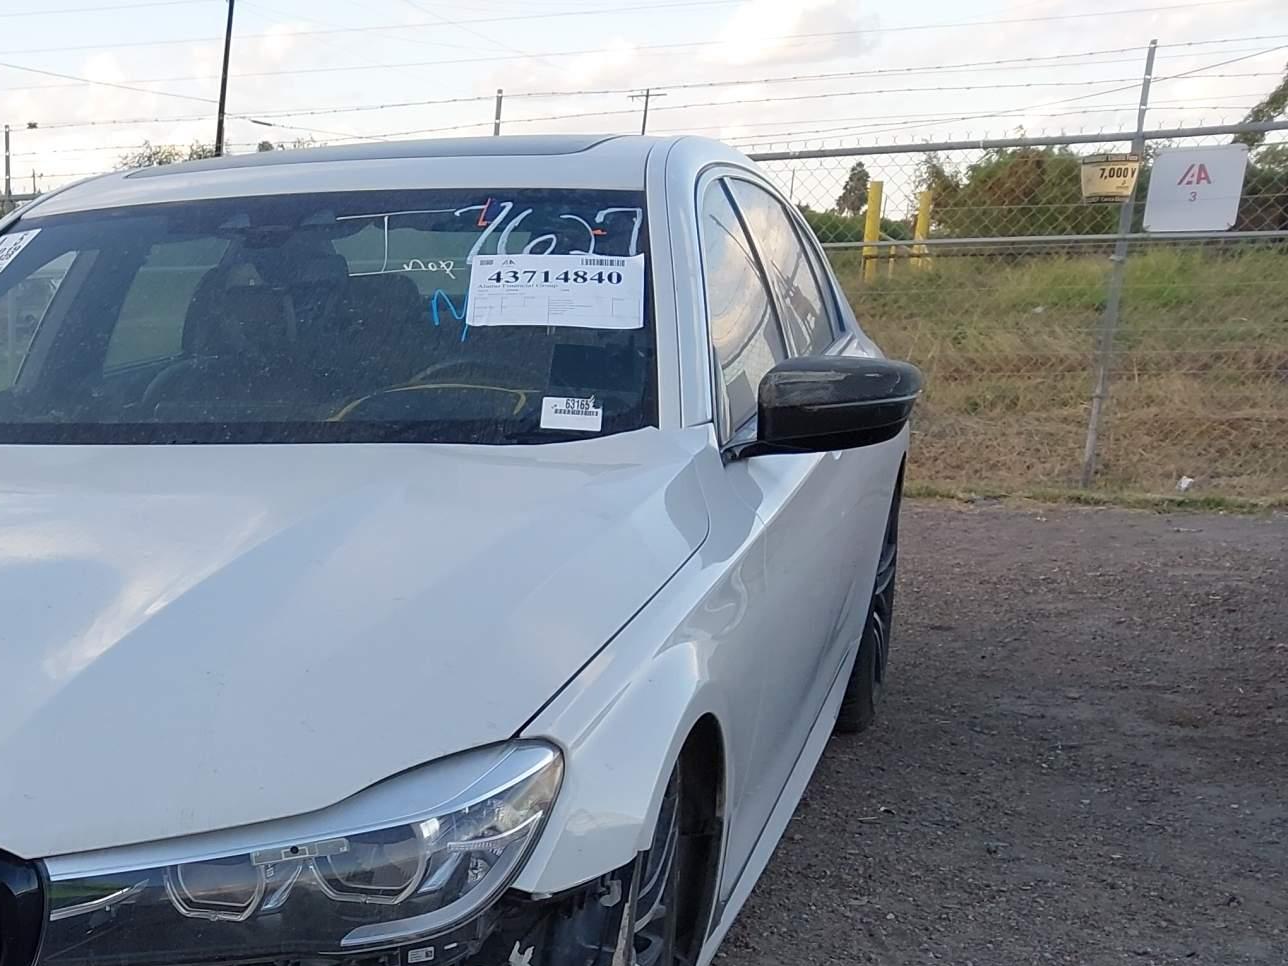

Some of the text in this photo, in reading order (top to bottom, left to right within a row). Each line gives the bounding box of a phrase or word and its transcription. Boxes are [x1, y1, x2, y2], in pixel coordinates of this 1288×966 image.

[1099, 167, 1129, 180] 7,000
[1188, 191, 1198, 202] 3
[487, 269, 623, 285] 43714840
[565, 398, 590, 410] 63165
